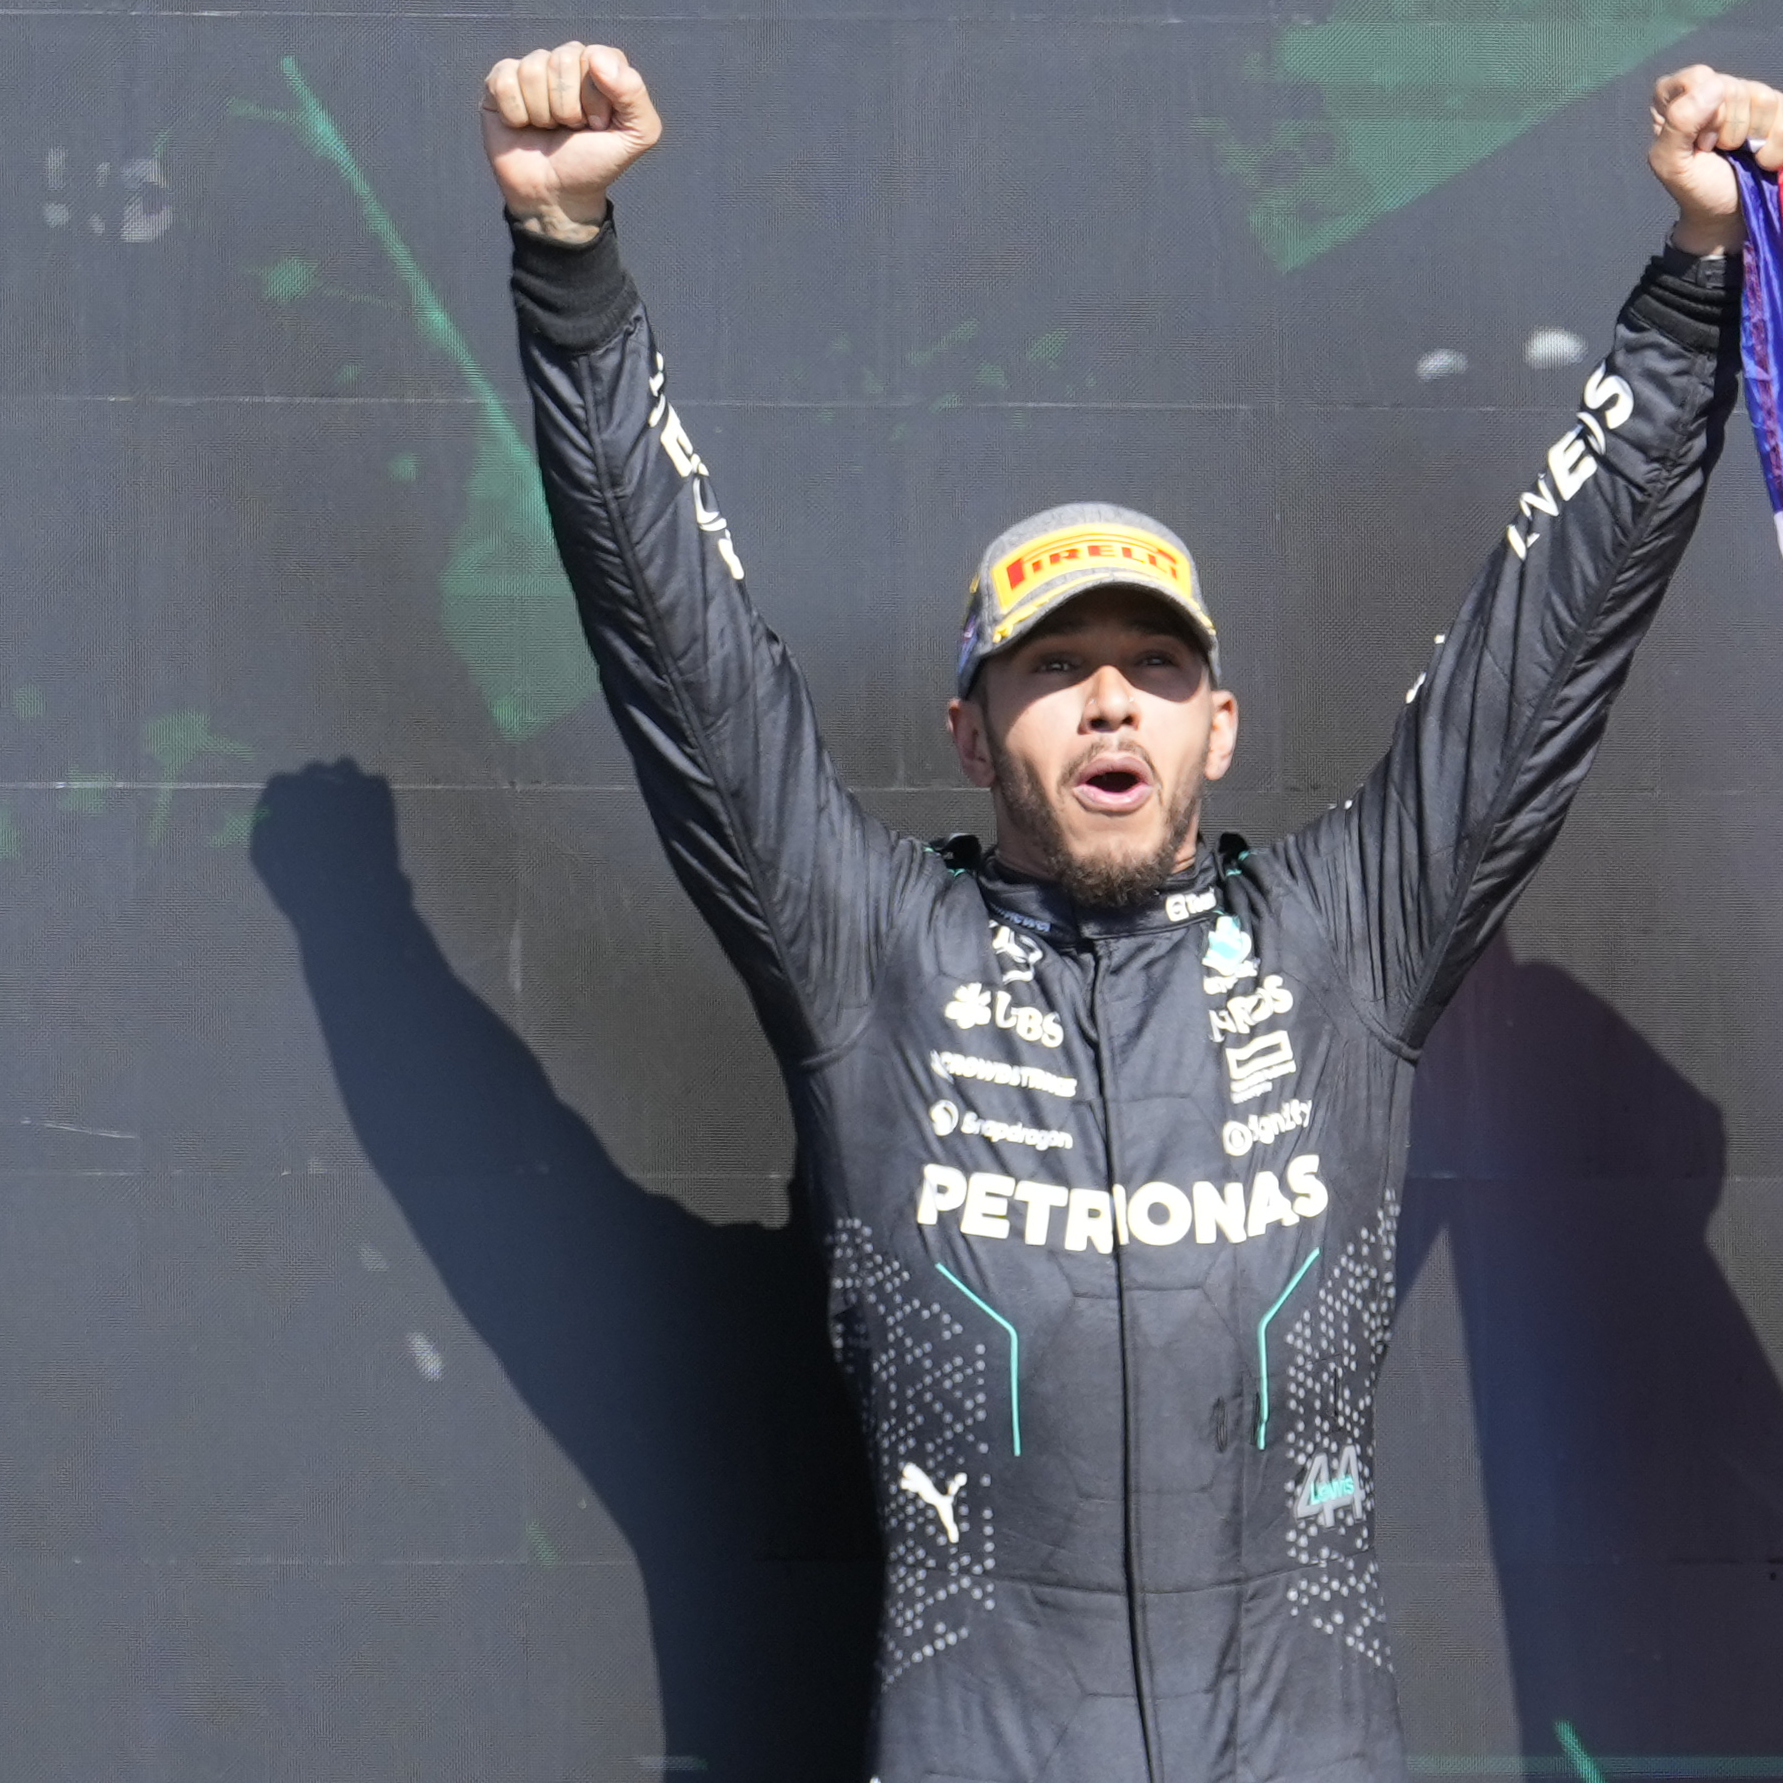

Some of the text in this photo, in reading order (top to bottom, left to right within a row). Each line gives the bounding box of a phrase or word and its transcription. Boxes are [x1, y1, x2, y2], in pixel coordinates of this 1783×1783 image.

[1006, 533, 1179, 591] PIRELLI
[917, 1155, 1328, 1254] PETRONAS
[1296, 1444, 1366, 1528] 44
